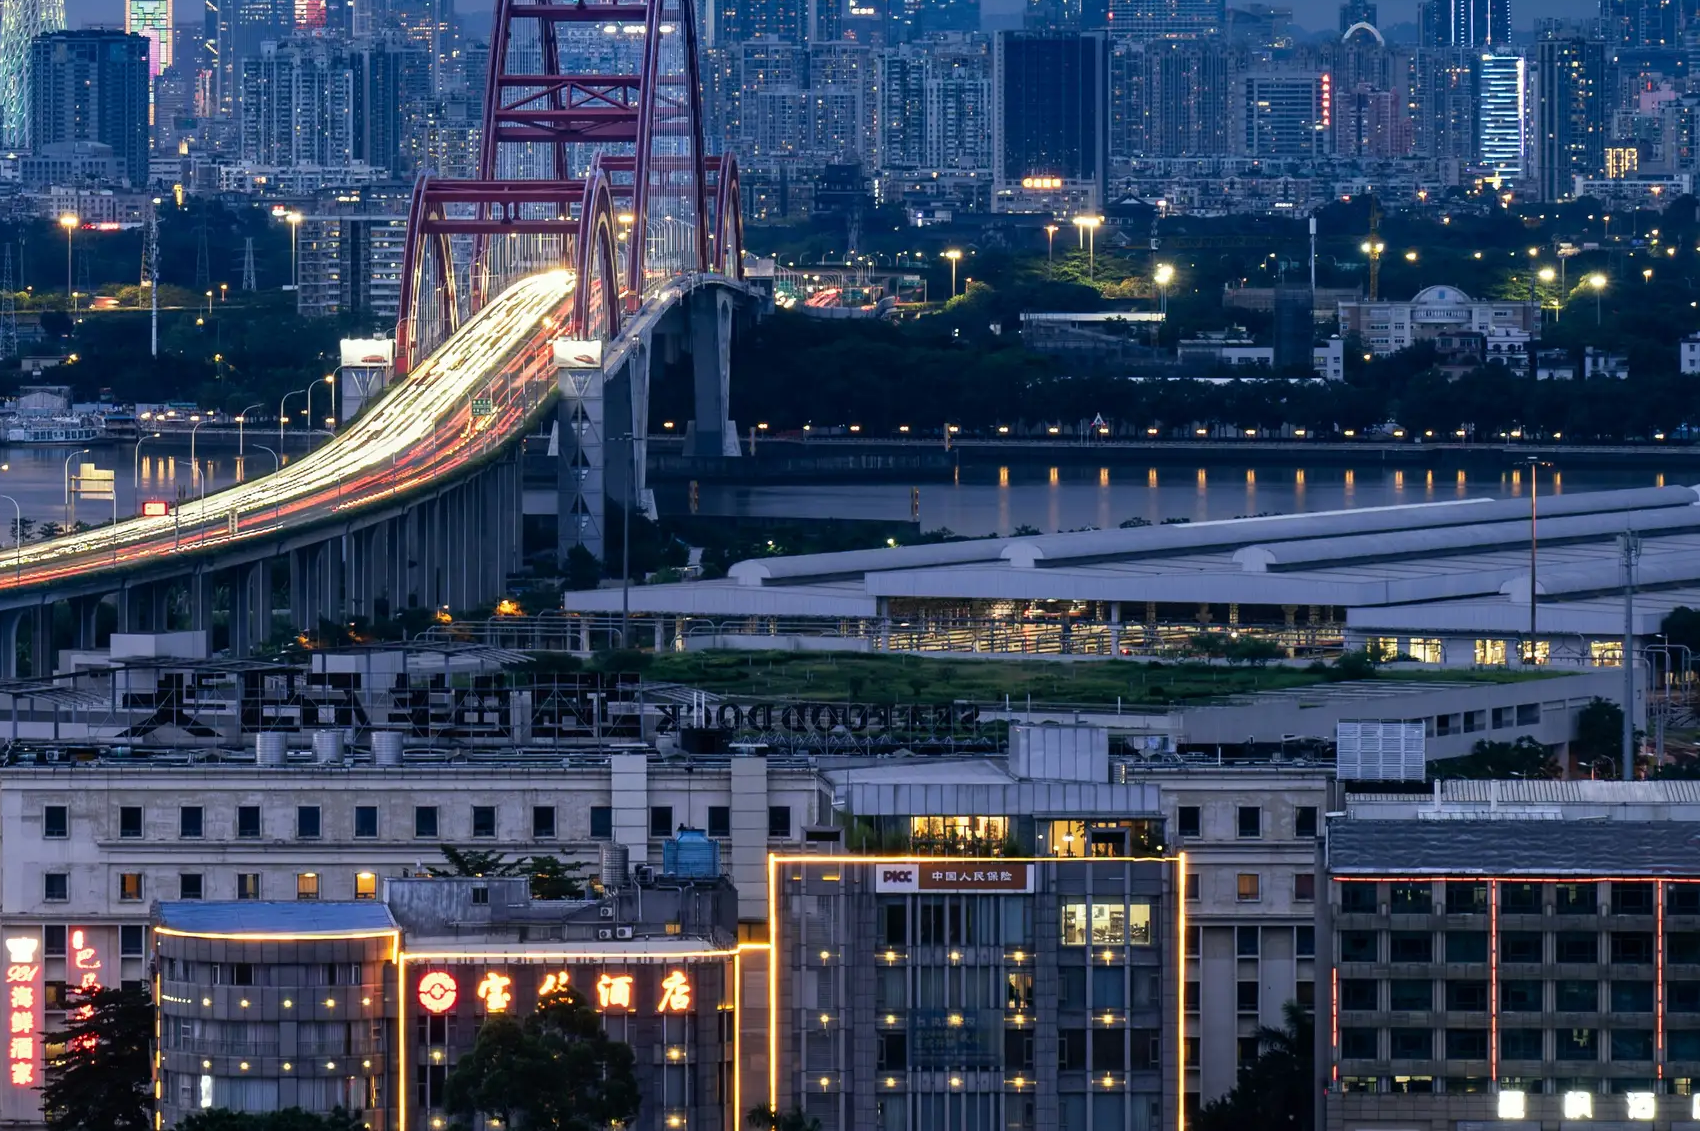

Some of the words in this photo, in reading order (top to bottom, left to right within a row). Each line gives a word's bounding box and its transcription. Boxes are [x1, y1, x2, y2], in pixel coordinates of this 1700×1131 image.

[883, 870, 913, 883] PICC
[931, 871, 1012, 882] 中国人民保险
[10, 984, 34, 1085] 海鲜酒家
